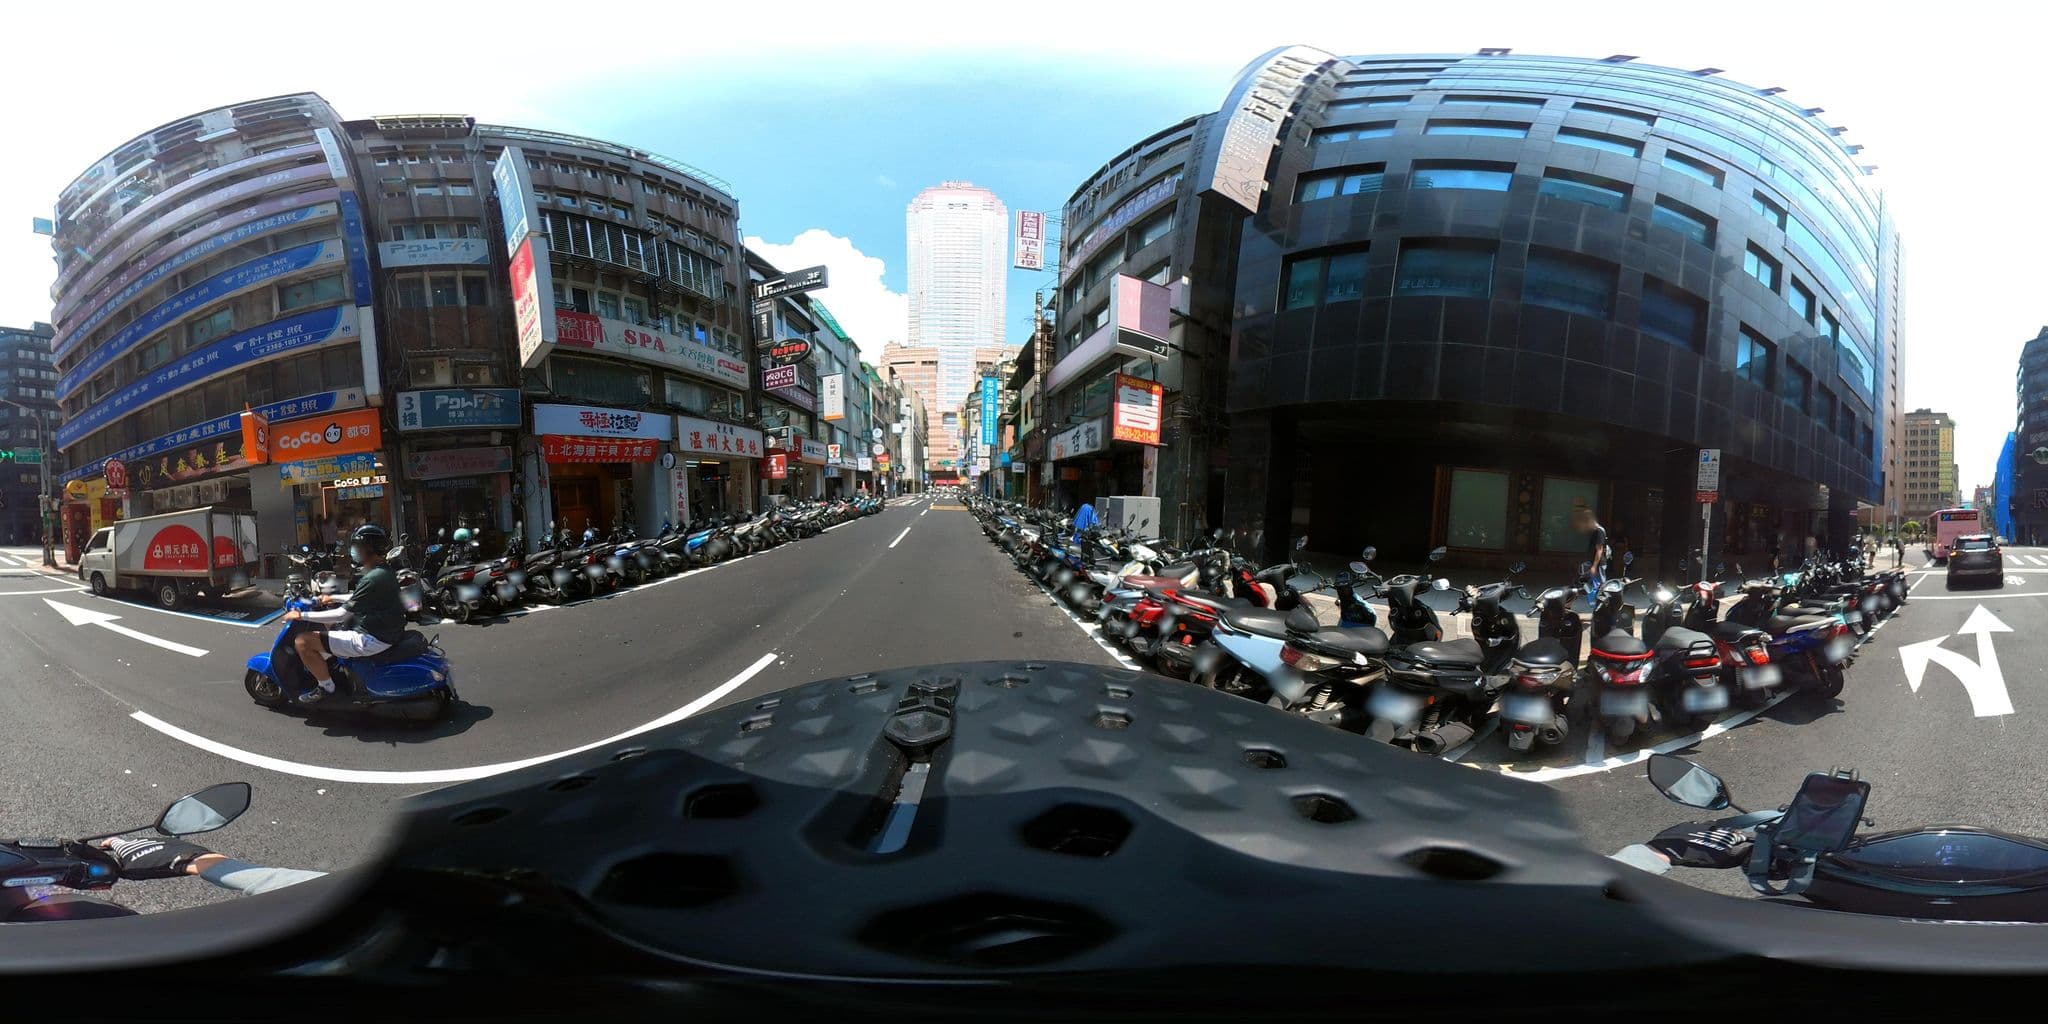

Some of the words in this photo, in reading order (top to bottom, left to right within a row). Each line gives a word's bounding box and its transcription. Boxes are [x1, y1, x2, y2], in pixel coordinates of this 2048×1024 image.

[232, 324, 304, 352] 會計證照
[624, 328, 666, 352] SPA
[164, 419, 231, 446] 不動產證照
[279, 431, 321, 449] CoCo
[334, 478, 359, 488] CoCo
